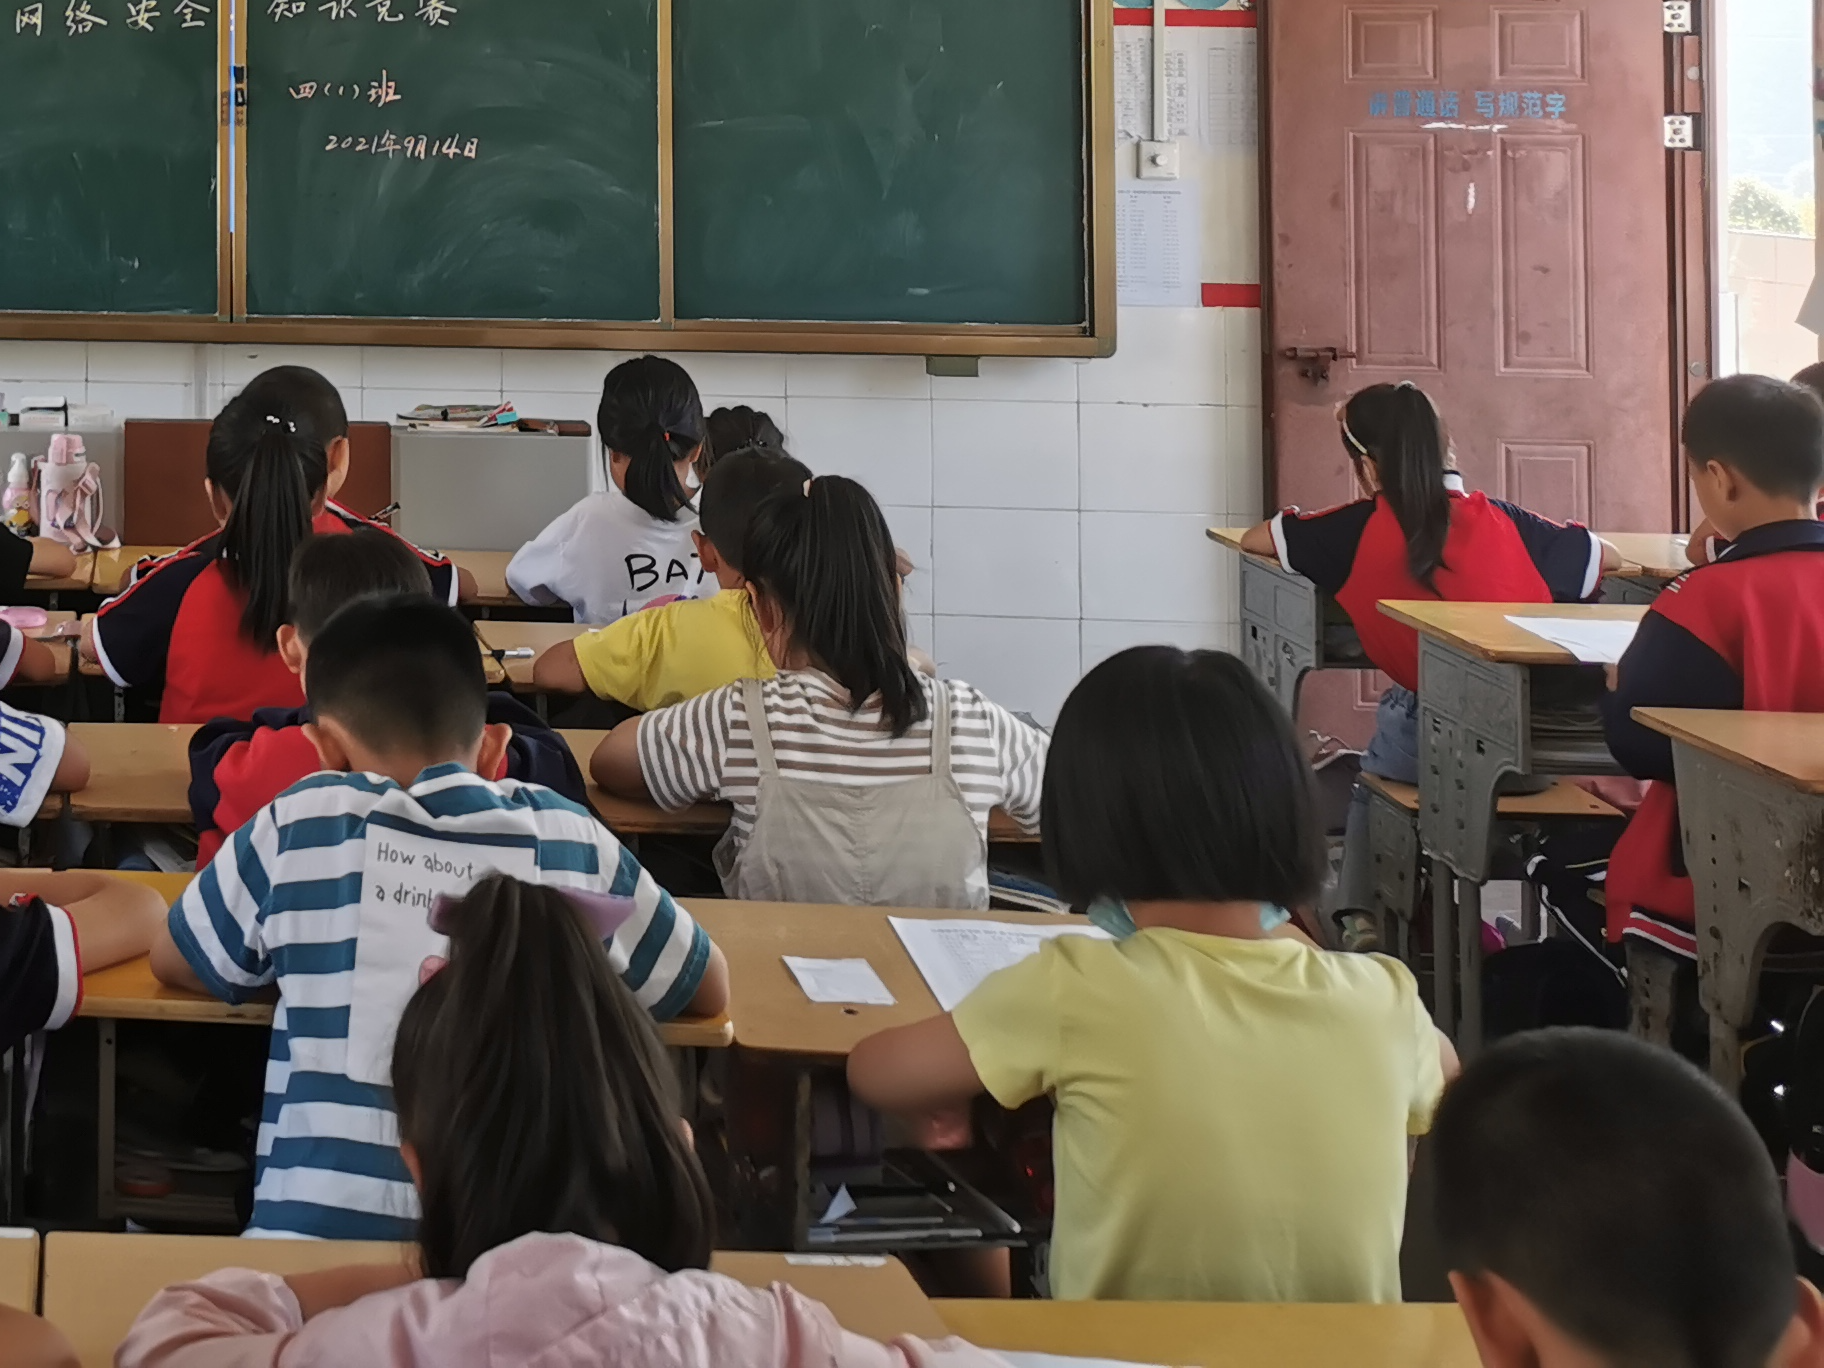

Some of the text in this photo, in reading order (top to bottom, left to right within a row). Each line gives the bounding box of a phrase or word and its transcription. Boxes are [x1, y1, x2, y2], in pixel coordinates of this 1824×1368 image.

[1474, 90, 1567, 120] 写规范字
[325, 130, 479, 160] 2021年9月14日
[377, 841, 475, 882] How about
[375, 884, 385, 902] a
